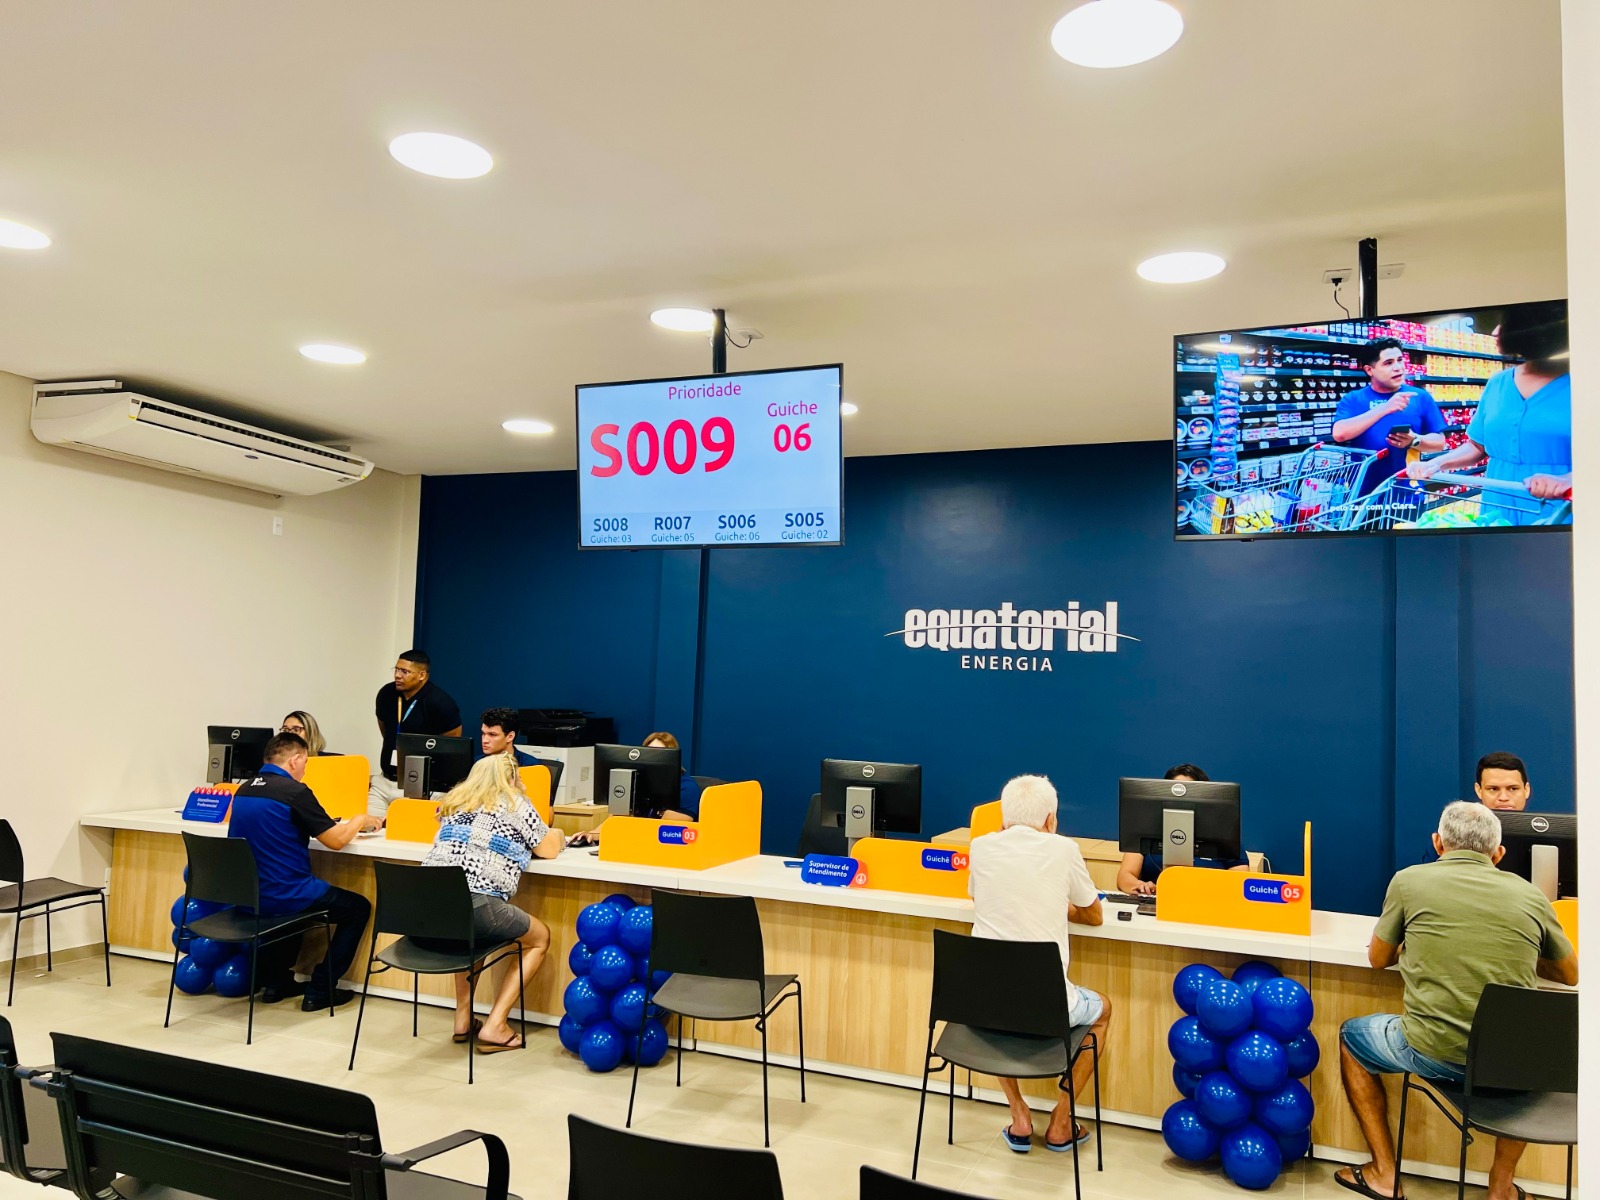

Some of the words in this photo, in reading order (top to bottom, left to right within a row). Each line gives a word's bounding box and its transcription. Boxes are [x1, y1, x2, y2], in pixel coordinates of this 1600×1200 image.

[668, 381, 742, 400] Prioridade
[767, 400, 818, 418] Guiche
[773, 422, 812, 453] 06
[590, 416, 735, 478] S009
[1391, 502, 1416, 510] Clara.
[593, 517, 628, 532] S008
[654, 516, 692, 531] R007
[718, 514, 756, 529] S006
[784, 512, 825, 528] S005
[590, 535, 620, 544] Guiche:
[621, 534, 632, 543] 03
[651, 533, 682, 543] Guiche:
[684, 533, 695, 542] 05
[714, 532, 747, 541] Guiche:
[748, 531, 760, 541] 06
[781, 530, 815, 540] Guiche:
[816, 529, 829, 539] 02
[904, 601, 1118, 653] equatorial
[961, 655, 1053, 672] ENERGIA
[684, 831, 695, 841] 03
[808, 860, 841, 870] Supervisor
[926, 855, 950, 864] Guichê
[953, 856, 967, 867] 04
[808, 867, 848, 878] Atendimento
[1249, 885, 1279, 895] Guichê
[1283, 887, 1300, 899] 05
